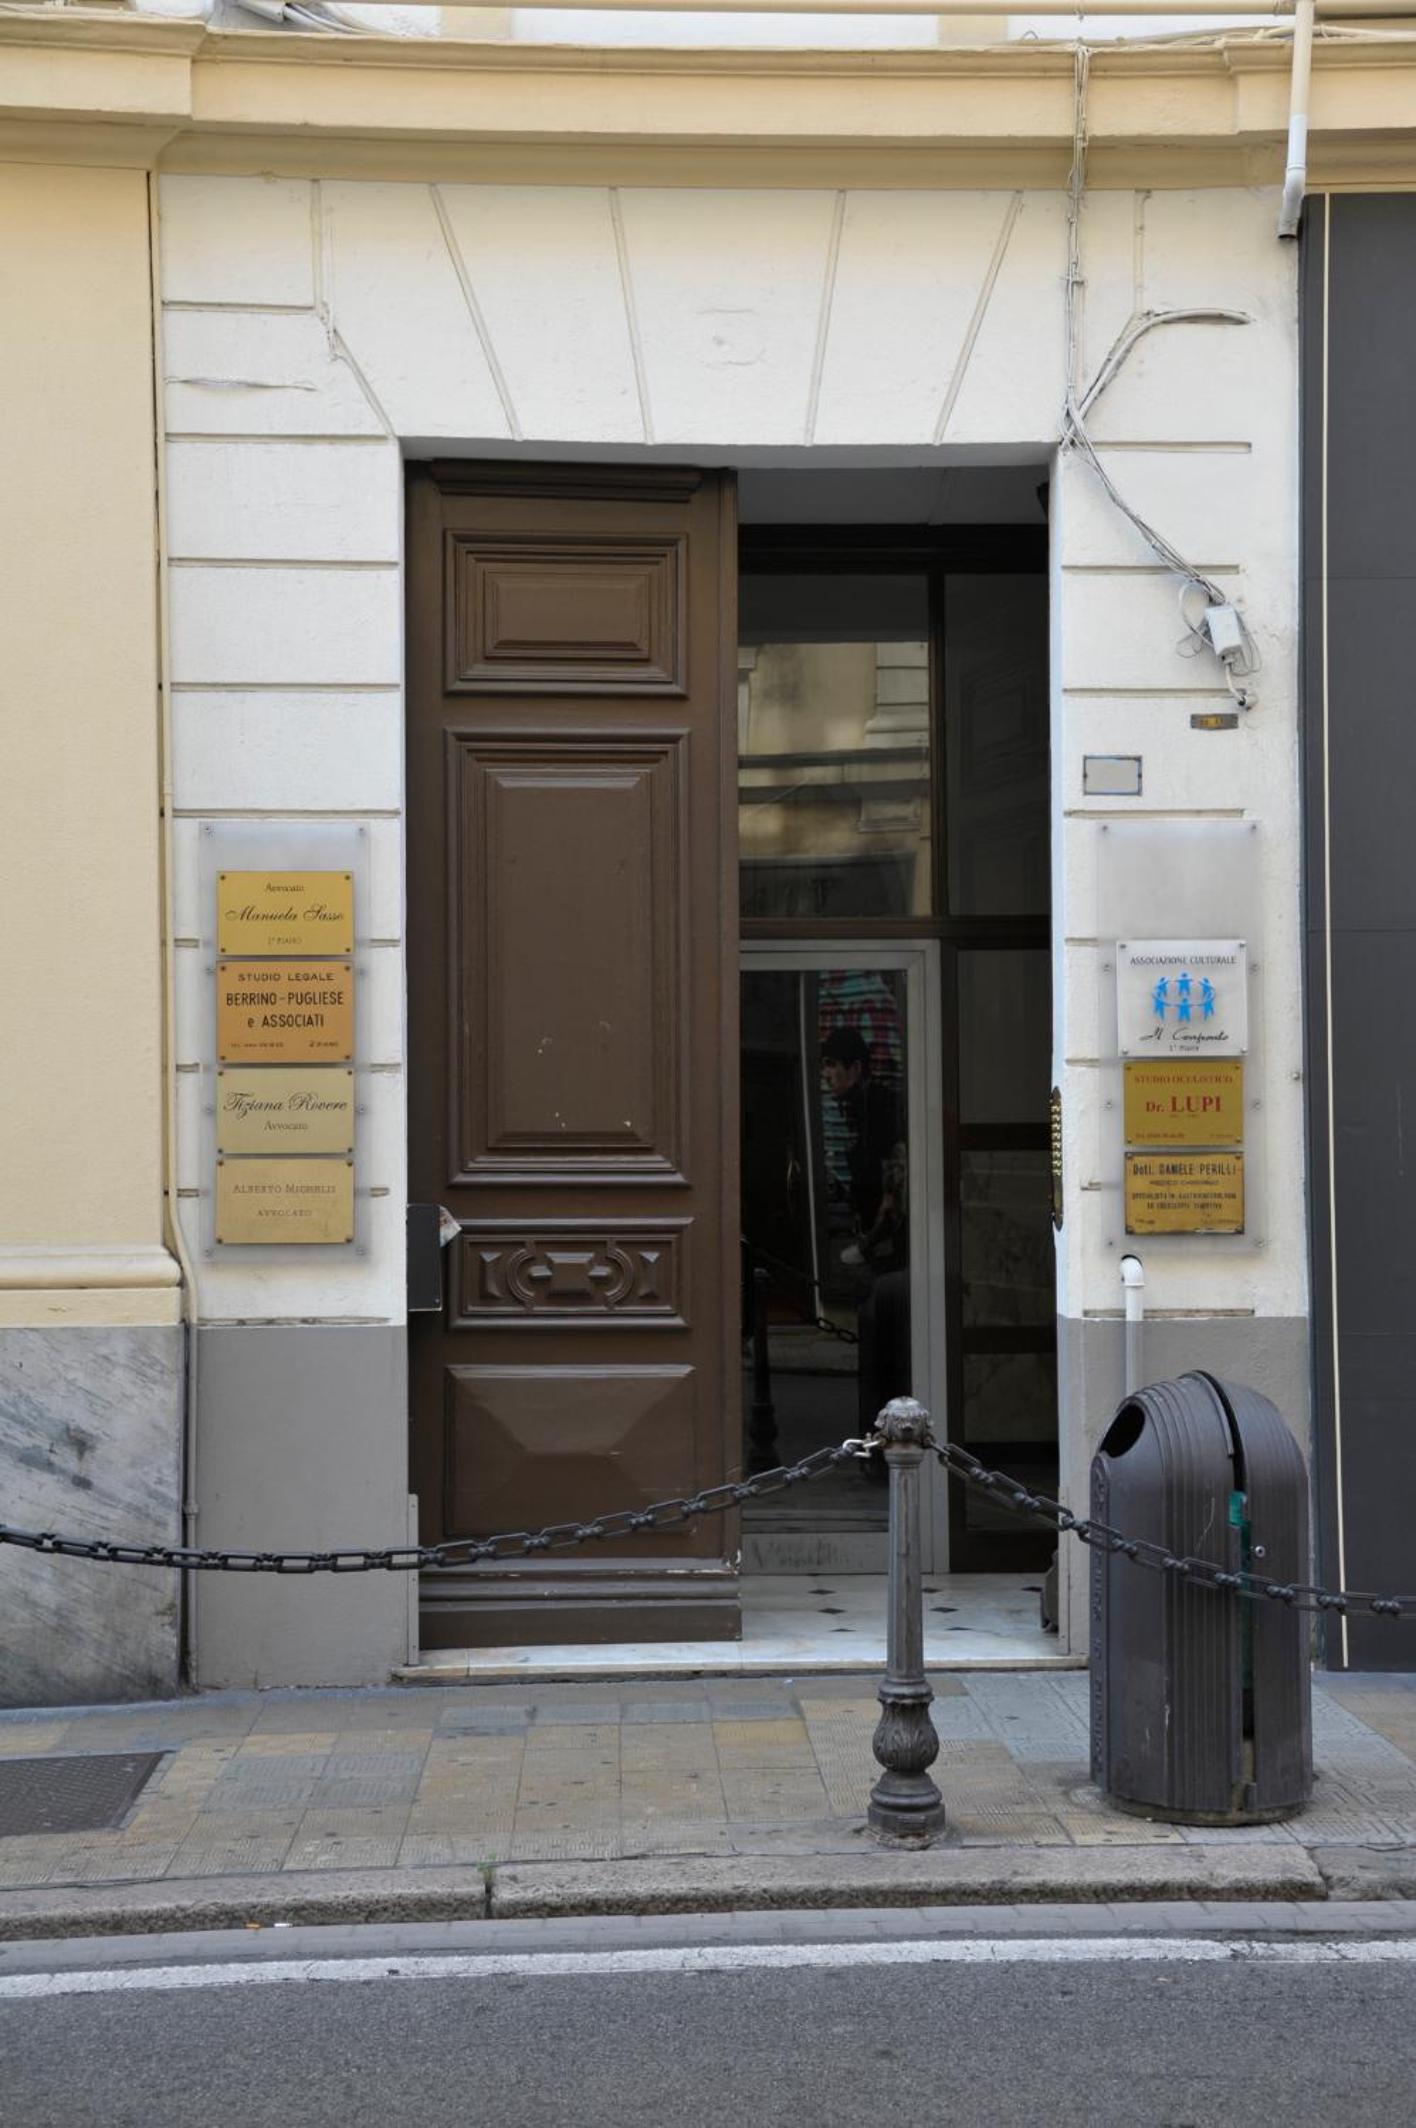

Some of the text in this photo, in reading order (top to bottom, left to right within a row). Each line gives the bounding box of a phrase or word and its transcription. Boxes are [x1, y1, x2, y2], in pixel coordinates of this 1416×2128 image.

[225, 905, 298, 920] Manuela
[1131, 956, 1236, 966] ASSOCIAZIONE CULTURALE
[238, 973, 334, 981] STUDIO LEGALE
[226, 992, 277, 1006] BERRINO
[288, 991, 344, 1005] PUGLIESE
[261, 1014, 324, 1028] ASSOCIATI
[288, 1091, 347, 1111] Rovere
[1171, 1096, 1221, 1112] LUPI
